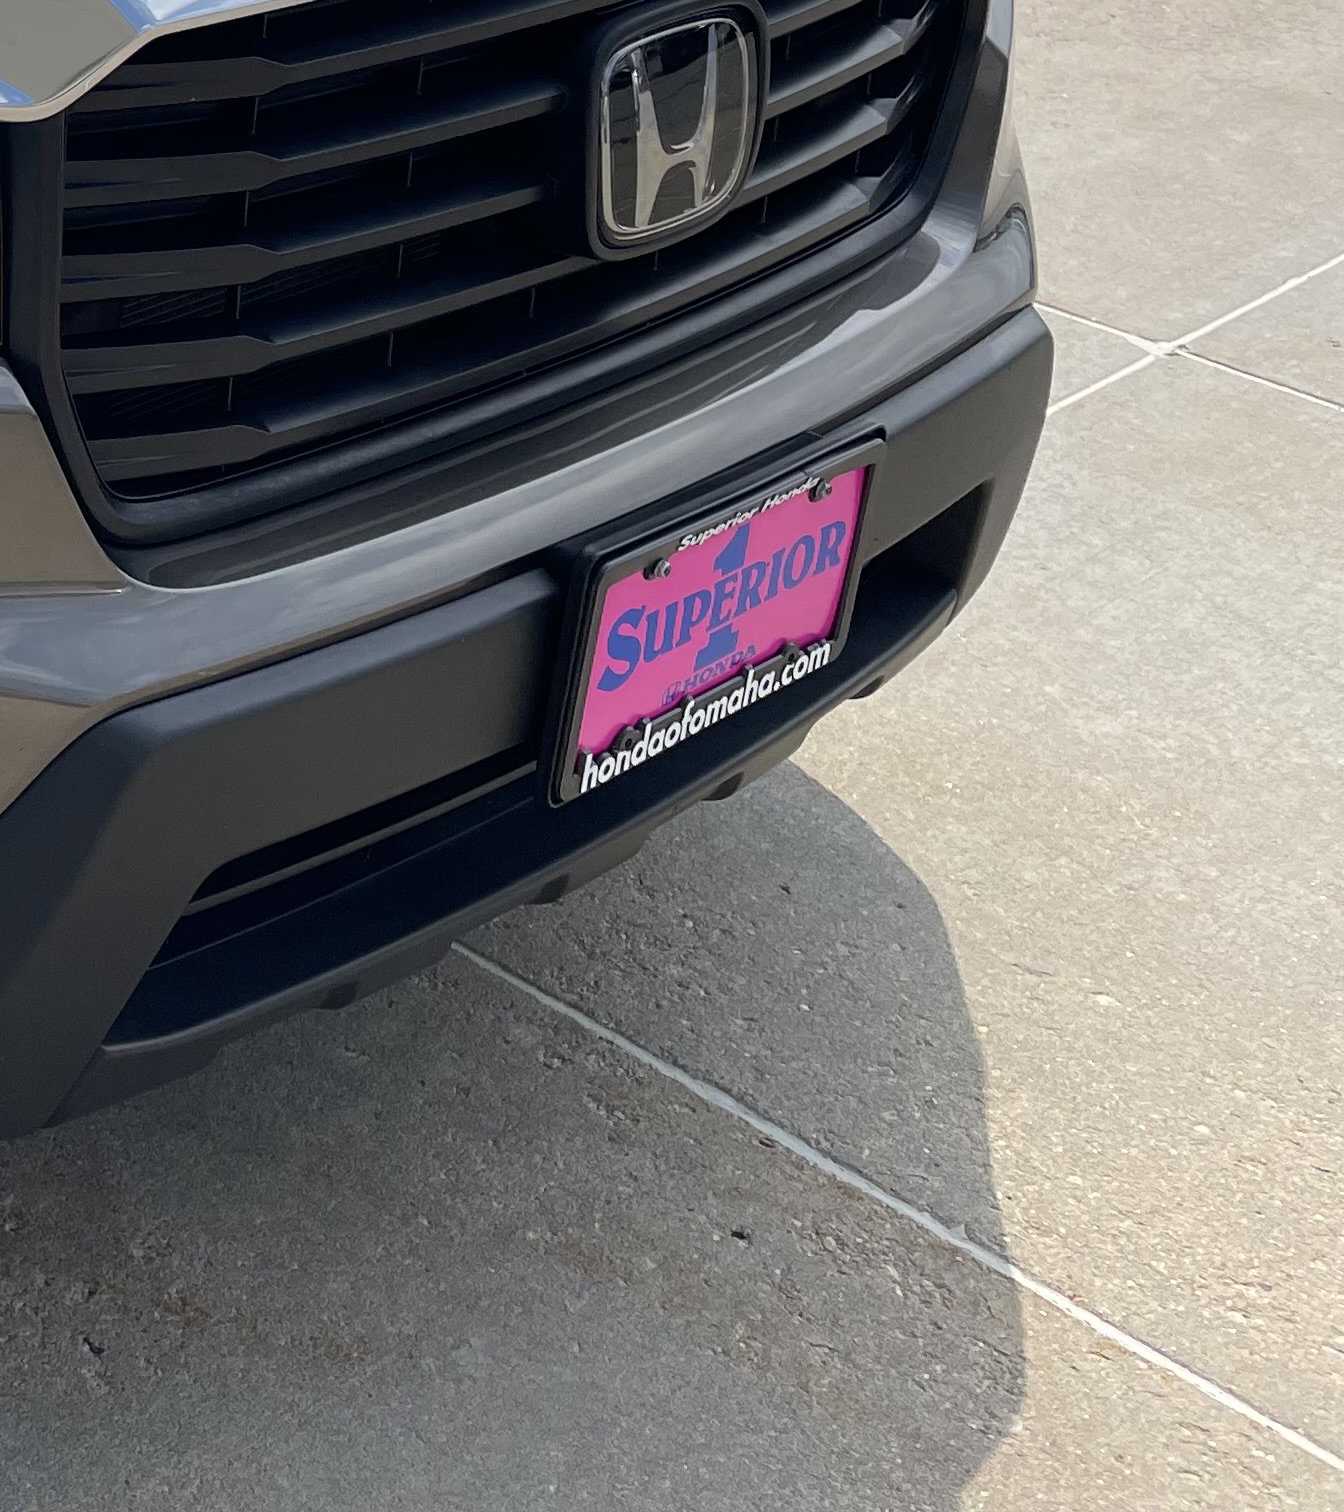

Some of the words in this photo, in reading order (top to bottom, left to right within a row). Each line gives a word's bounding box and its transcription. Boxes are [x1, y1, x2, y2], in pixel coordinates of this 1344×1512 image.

[678, 507, 759, 551] Superior
[598, 521, 846, 691] SUPERIOR
[580, 643, 830, 794] hondaofomaha.com
[683, 645, 758, 693] HONDA
